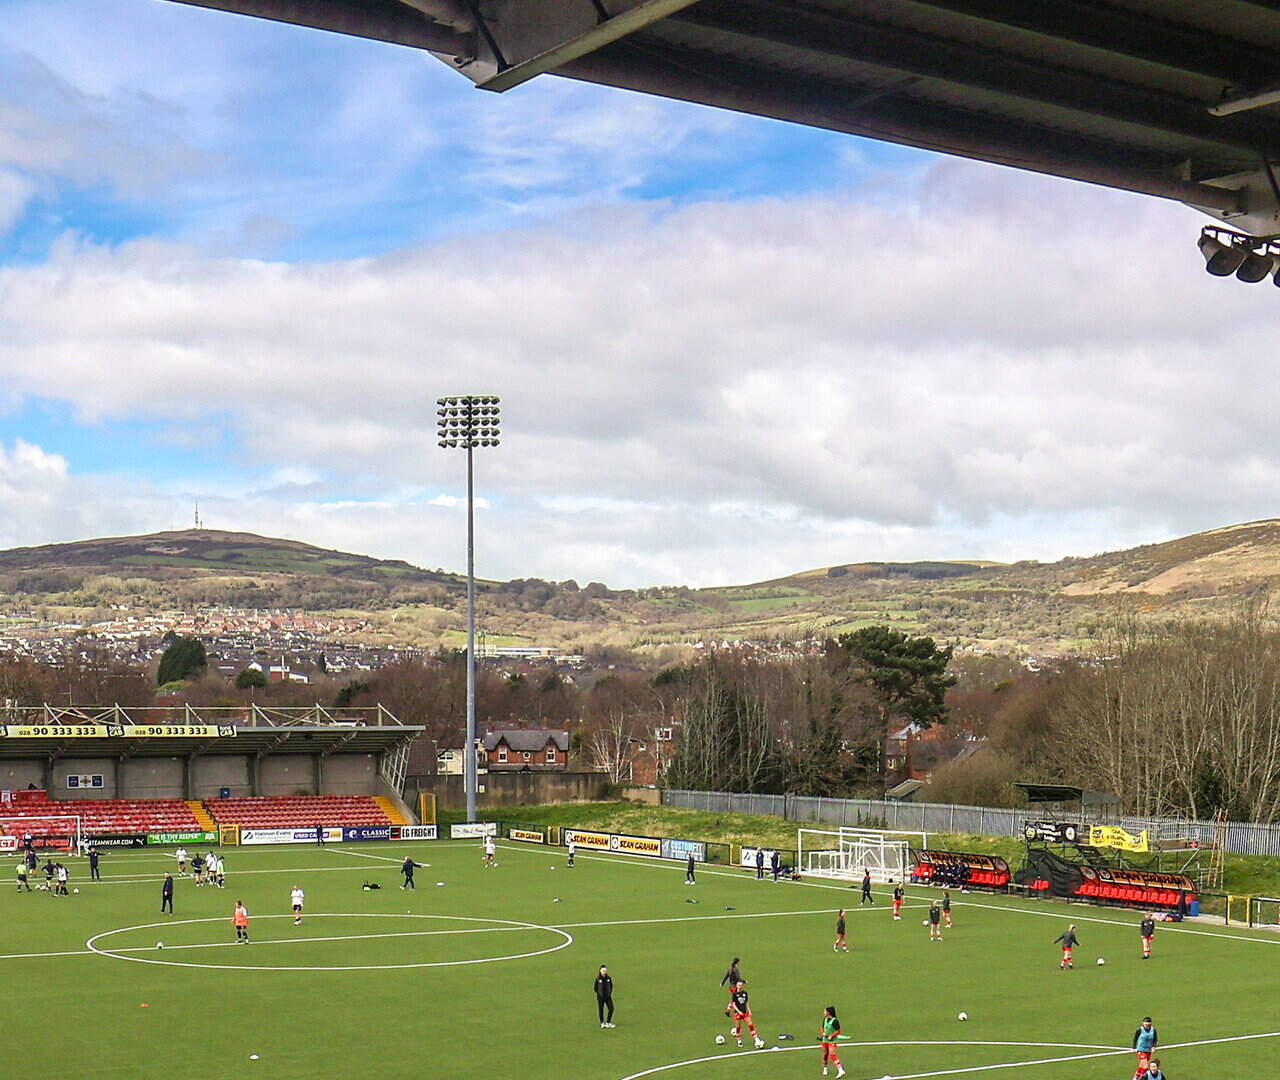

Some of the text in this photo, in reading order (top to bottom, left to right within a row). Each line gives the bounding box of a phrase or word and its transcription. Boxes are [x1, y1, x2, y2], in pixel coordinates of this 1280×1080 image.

[76, 727, 96, 735] 333
[166, 727, 185, 735] 333
[189, 727, 208, 735] 333
[402, 825, 435, 838] EG FREIGHT
[573, 835, 609, 846] SEAN GRAHAM
[619, 840, 659, 852] SEAN GRAHAM
